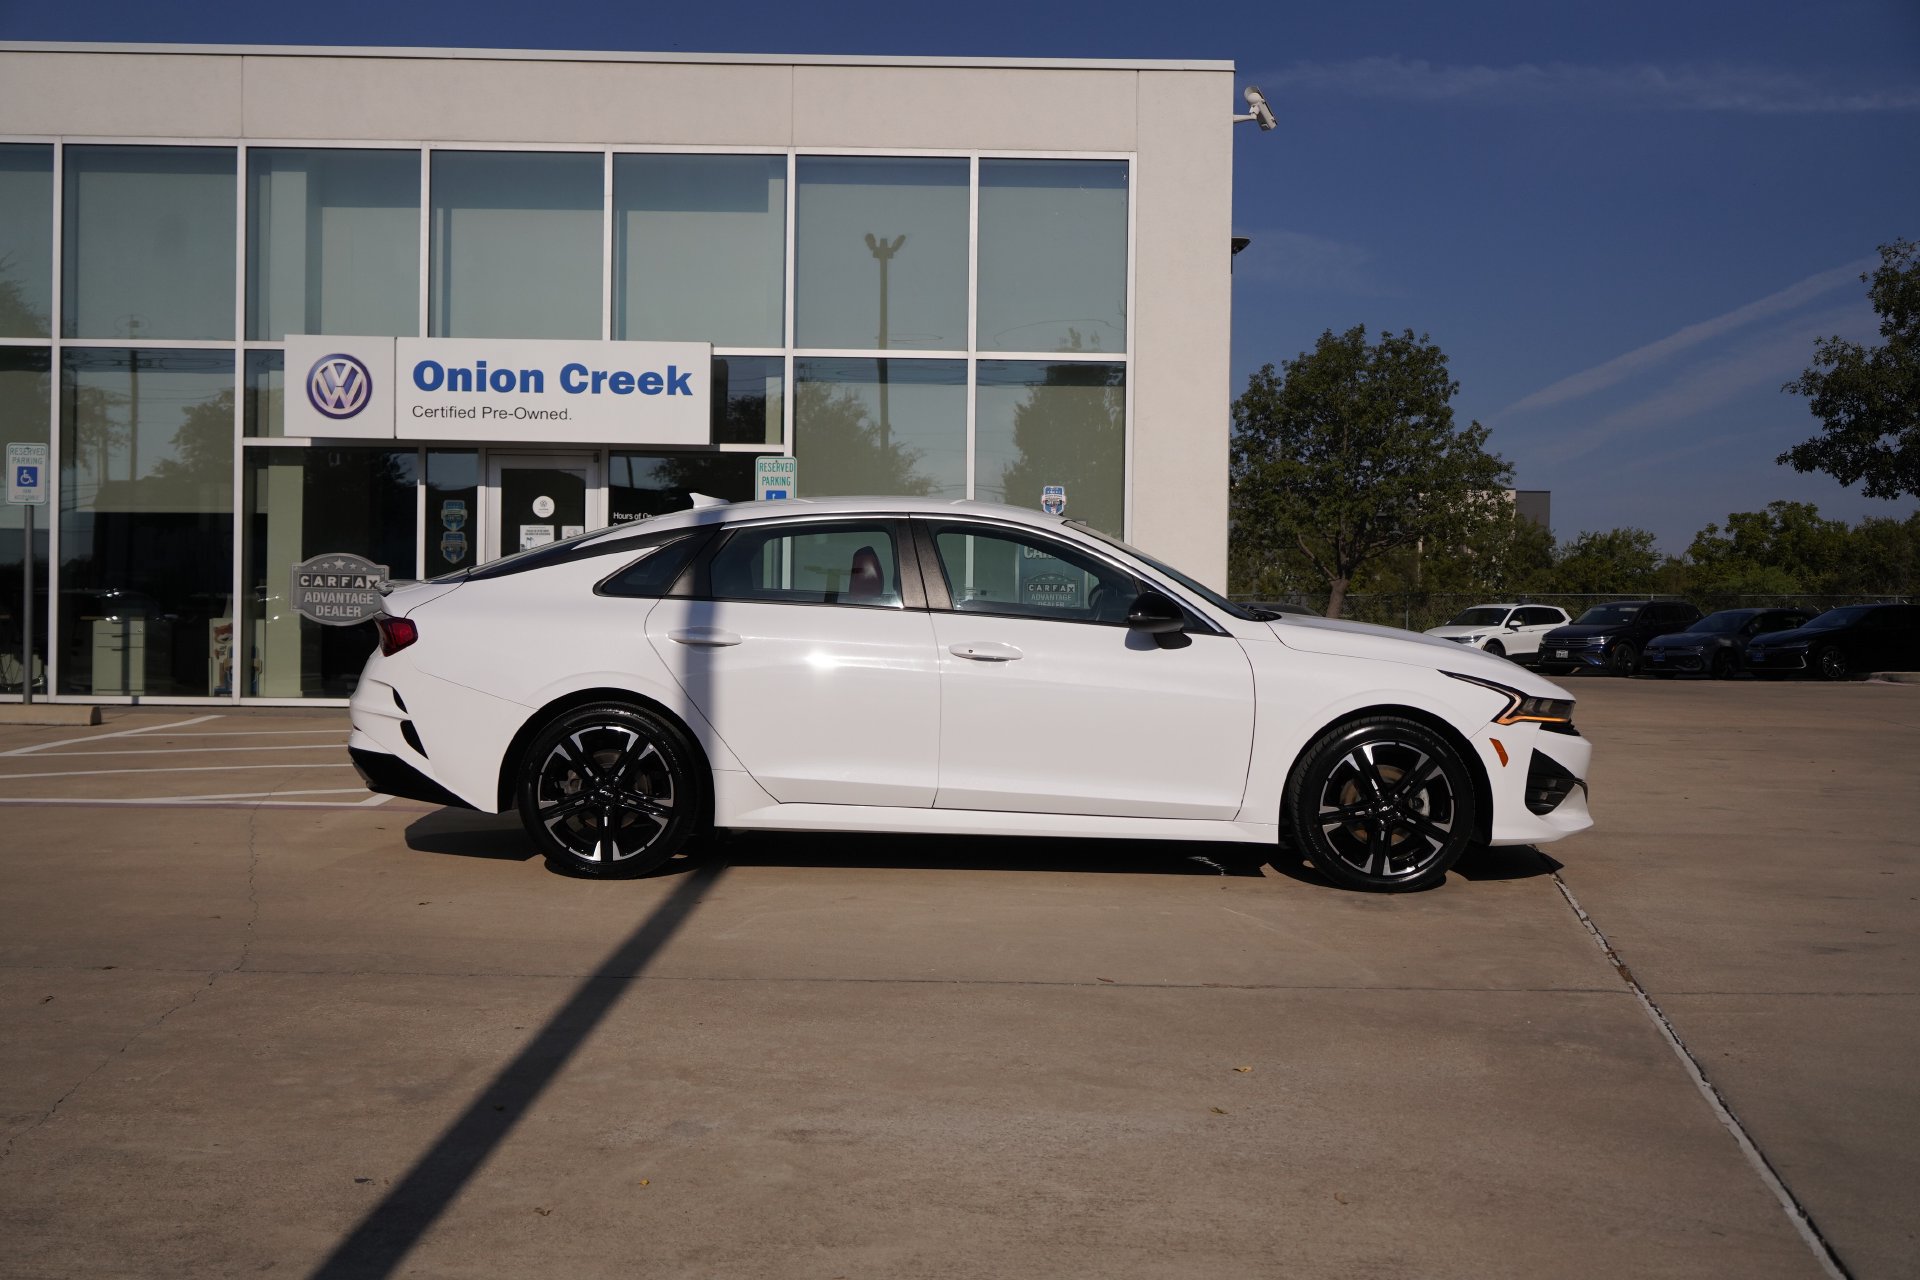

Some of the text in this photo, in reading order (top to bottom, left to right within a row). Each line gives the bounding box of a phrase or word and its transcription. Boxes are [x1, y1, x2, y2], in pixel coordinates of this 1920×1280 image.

[413, 360, 693, 396] Onion Creek
[412, 405, 572, 421] Certified Pre-Owned.
[10, 447, 46, 456] RESERVED
[12, 456, 44, 465] PARKING
[759, 462, 794, 473] RESERVED
[762, 476, 791, 487] PARKING
[613, 511, 633, 520] Hours
[634, 512, 642, 520] of
[300, 575, 379, 590] CARFAX
[1028, 584, 1075, 593] CARFAX
[303, 591, 375, 605] ADVANTAGE
[1031, 593, 1072, 601] ADVANTAGE
[315, 605, 362, 617] DEALER
